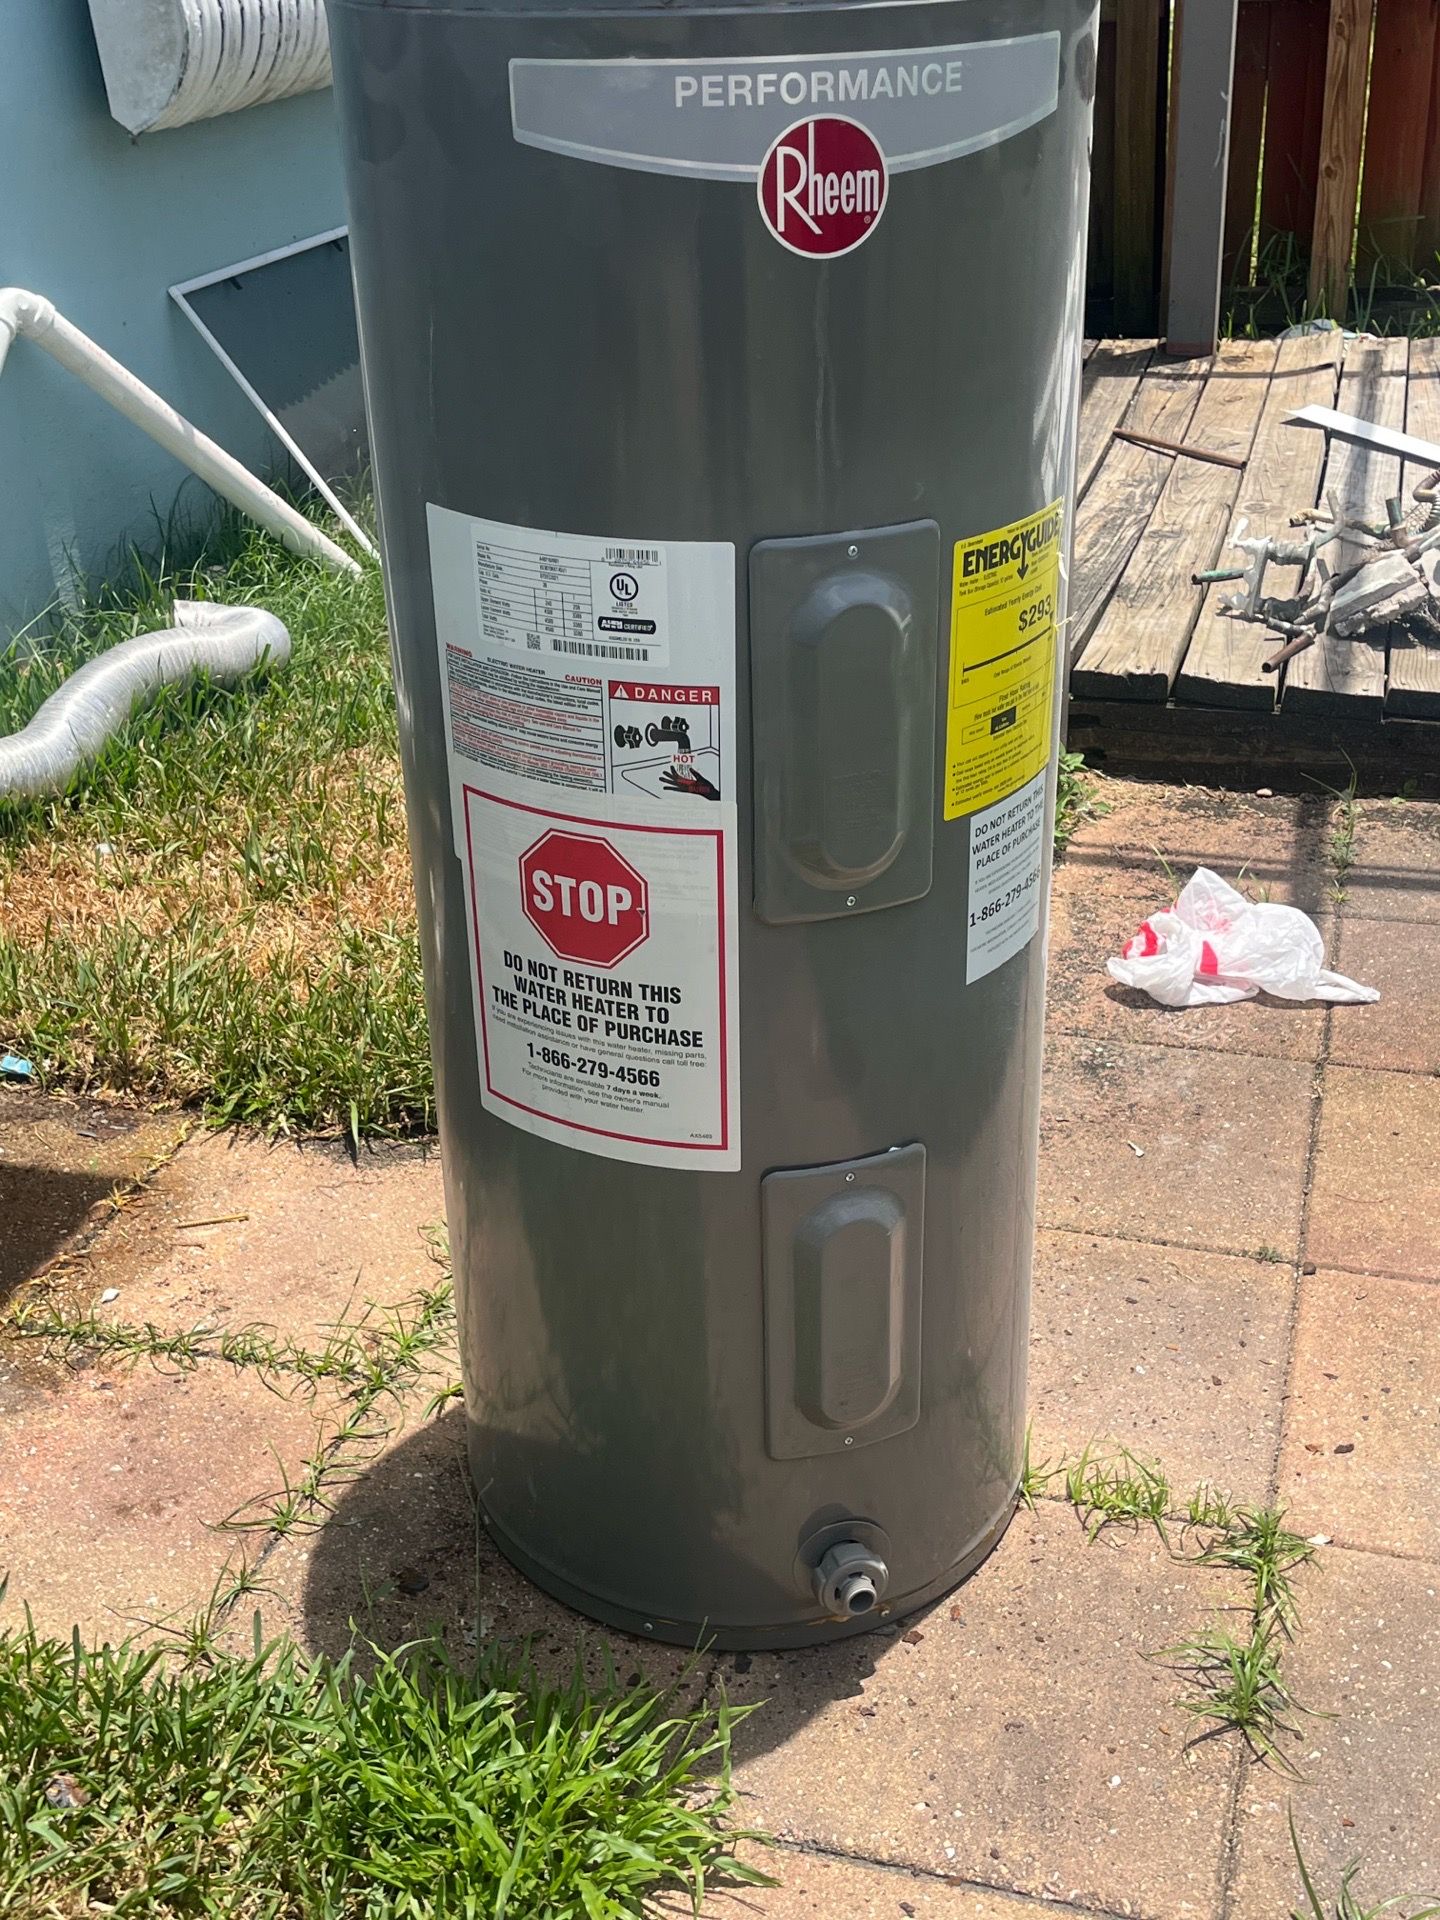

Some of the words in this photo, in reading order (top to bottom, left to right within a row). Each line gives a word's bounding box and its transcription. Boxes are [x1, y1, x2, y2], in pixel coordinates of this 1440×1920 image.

[675, 61, 962, 107] PERFORMANCE
[776, 121, 879, 234] Rheem
[616, 578, 632, 596] UL
[985, 602, 1008, 616] Estimated
[1018, 594, 1051, 634] $293
[487, 656, 508, 666] ELECTRIC
[526, 666, 546, 675] HEATER
[564, 674, 602, 686] CAUTION
[634, 686, 712, 702] DANGER
[673, 754, 695, 764] HOT
[972, 834, 1000, 855] WATER
[1002, 816, 1026, 840] HEATER
[1026, 809, 1034, 820] TO
[1034, 798, 1044, 813] THE
[975, 823, 988, 838] DO
[990, 812, 1006, 830] NOT
[1008, 796, 1032, 820] RETURN
[1032, 784, 1044, 800] THIS
[976, 848, 1000, 870] PLACE
[1002, 842, 1011, 856] OF
[1012, 817, 1040, 849] PURCHASE
[532, 869, 633, 926] STOP
[970, 864, 1040, 928] 1-866-279-4566
[504, 950, 522, 972] DO
[528, 959, 558, 982] NOT
[564, 970, 632, 998] RETURN
[638, 984, 681, 1004] THIS
[514, 974, 566, 1006] WATER
[572, 992, 640, 1020] HEATER
[645, 1006, 669, 1024] TO
[492, 985, 518, 1010] THE
[522, 998, 572, 1028] PLACE
[577, 1015, 598, 1034] OF
[605, 1020, 704, 1048] PURCHASE
[496, 1008, 506, 1016] you
[507, 1012, 516, 1020] are
[517, 1016, 555, 1035] experiencing
[556, 1028, 576, 1040] issues
[578, 1034, 592, 1042] with
[607, 1042, 626, 1050] water
[628, 1044, 652, 1054] heater,
[654, 1049, 684, 1058] missing
[685, 1052, 706, 1060] parts,
[507, 1020, 536, 1036] installation
[537, 1032, 570, 1046] assistance
[580, 1044, 596, 1052] have
[598, 1048, 624, 1058] general
[626, 1054, 660, 1064] questions
[662, 1056, 675, 1065] call
[527, 1042, 660, 1087] 1-866-279-4566
[522, 1068, 532, 1076] For
[532, 1073, 548, 1082] more
[550, 1078, 586, 1094] information,
[602, 1092, 612, 1100] the
[614, 1095, 641, 1105] owner's
[642, 1100, 670, 1108] manual
[528, 1061, 562, 1078] Technicians
[564, 1074, 574, 1082] are
[576, 1078, 604, 1090] available
[612, 1086, 630, 1095] days
[639, 1090, 662, 1099] week.
[542, 1084, 568, 1096] provided
[600, 1100, 620, 1109] water
[620, 1104, 644, 1114] heater.
